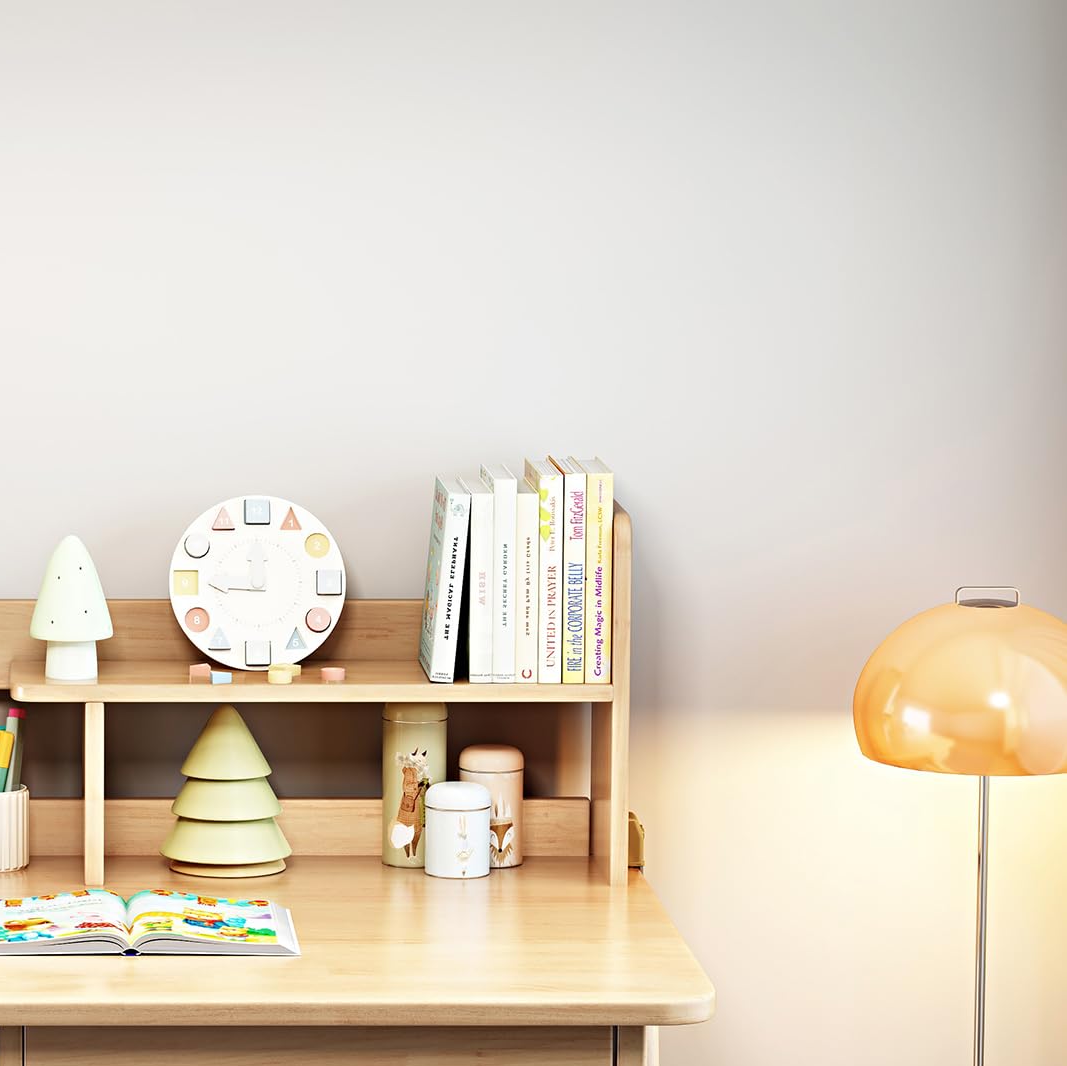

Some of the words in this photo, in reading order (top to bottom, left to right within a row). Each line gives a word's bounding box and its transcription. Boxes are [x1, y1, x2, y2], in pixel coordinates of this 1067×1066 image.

[288, 519, 294, 527] 1
[569, 526, 583, 540] Tom
[568, 562, 583, 585] BELLY
[594, 566, 602, 597] Midlife
[546, 565, 556, 607] PRAYER
[567, 586, 583, 633] CORPORATE
[594, 599, 602, 608] in
[193, 615, 200, 625] 8
[594, 609, 604, 637] Magic
[292, 638, 299, 646] 5
[546, 621, 556, 668] UNITED
[567, 633, 582, 646] the
[567, 646, 582, 655] in
[593, 639, 603, 677] Creating
[567, 656, 582, 672] FIRE
